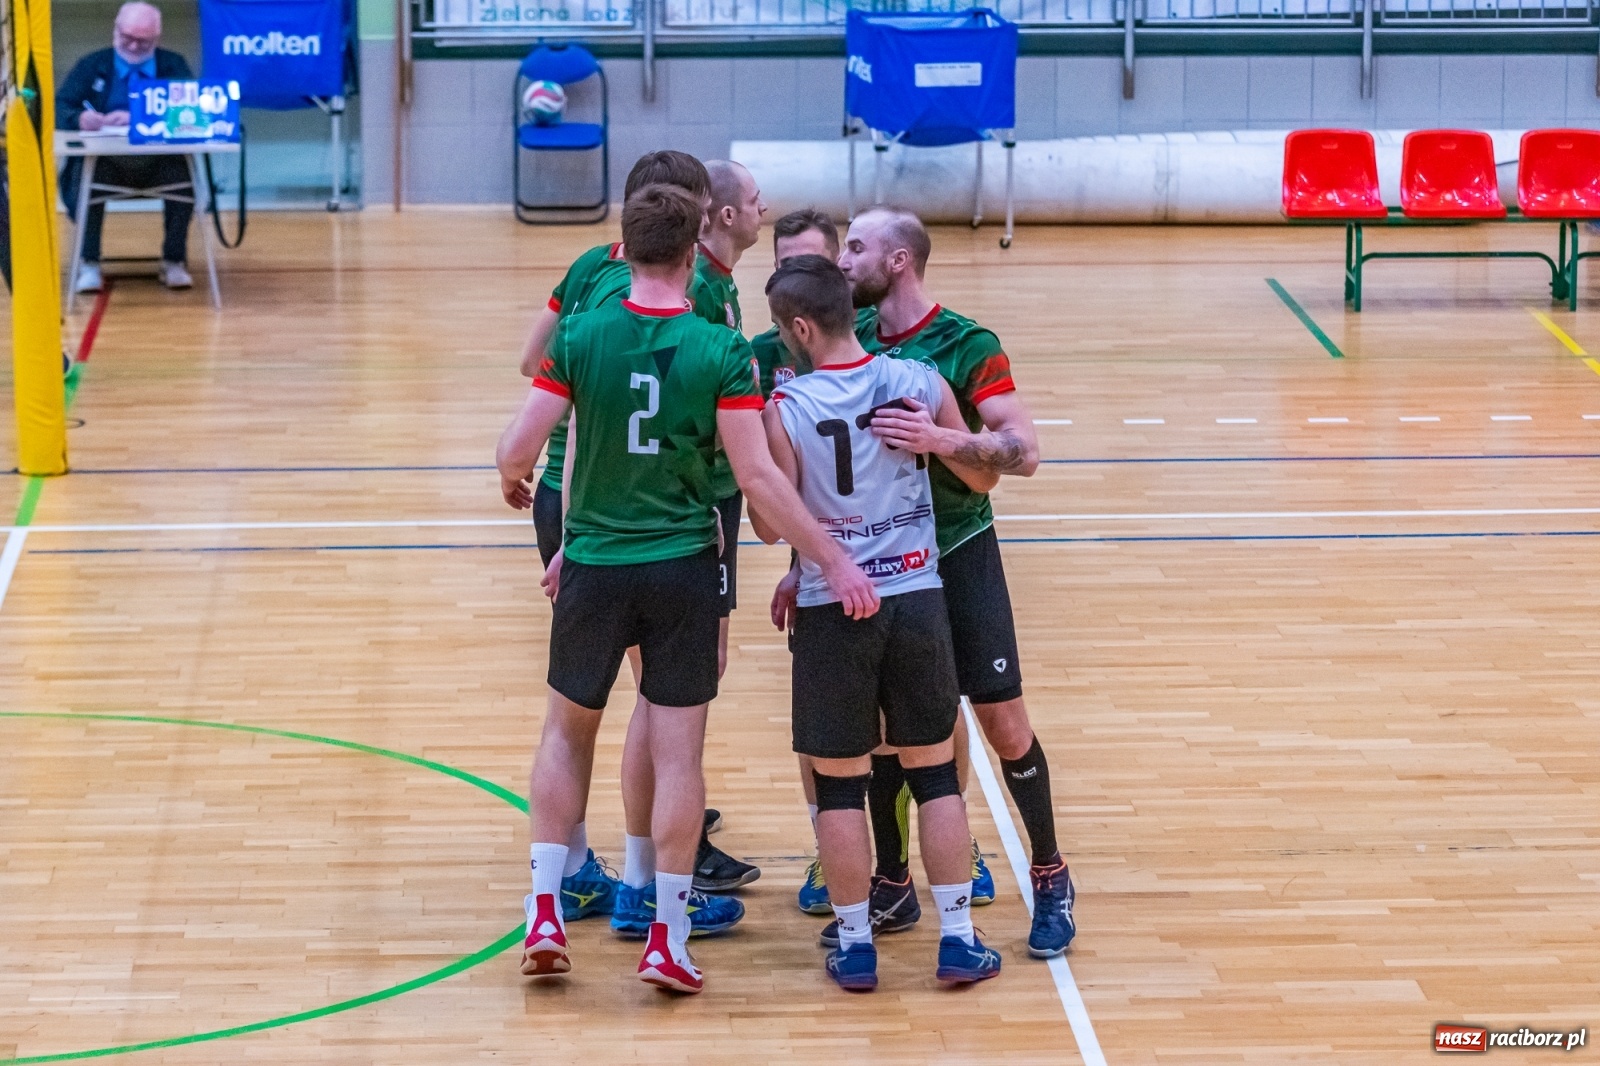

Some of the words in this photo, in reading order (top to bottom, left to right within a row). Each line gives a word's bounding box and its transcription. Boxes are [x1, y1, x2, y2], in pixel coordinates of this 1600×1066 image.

[223, 31, 320, 56] molten
[143, 86, 167, 116] 16
[628, 372, 660, 455] 2
[816, 396, 927, 496] 1
[817, 515, 863, 526] ADIO
[825, 504, 931, 540] ANESS
